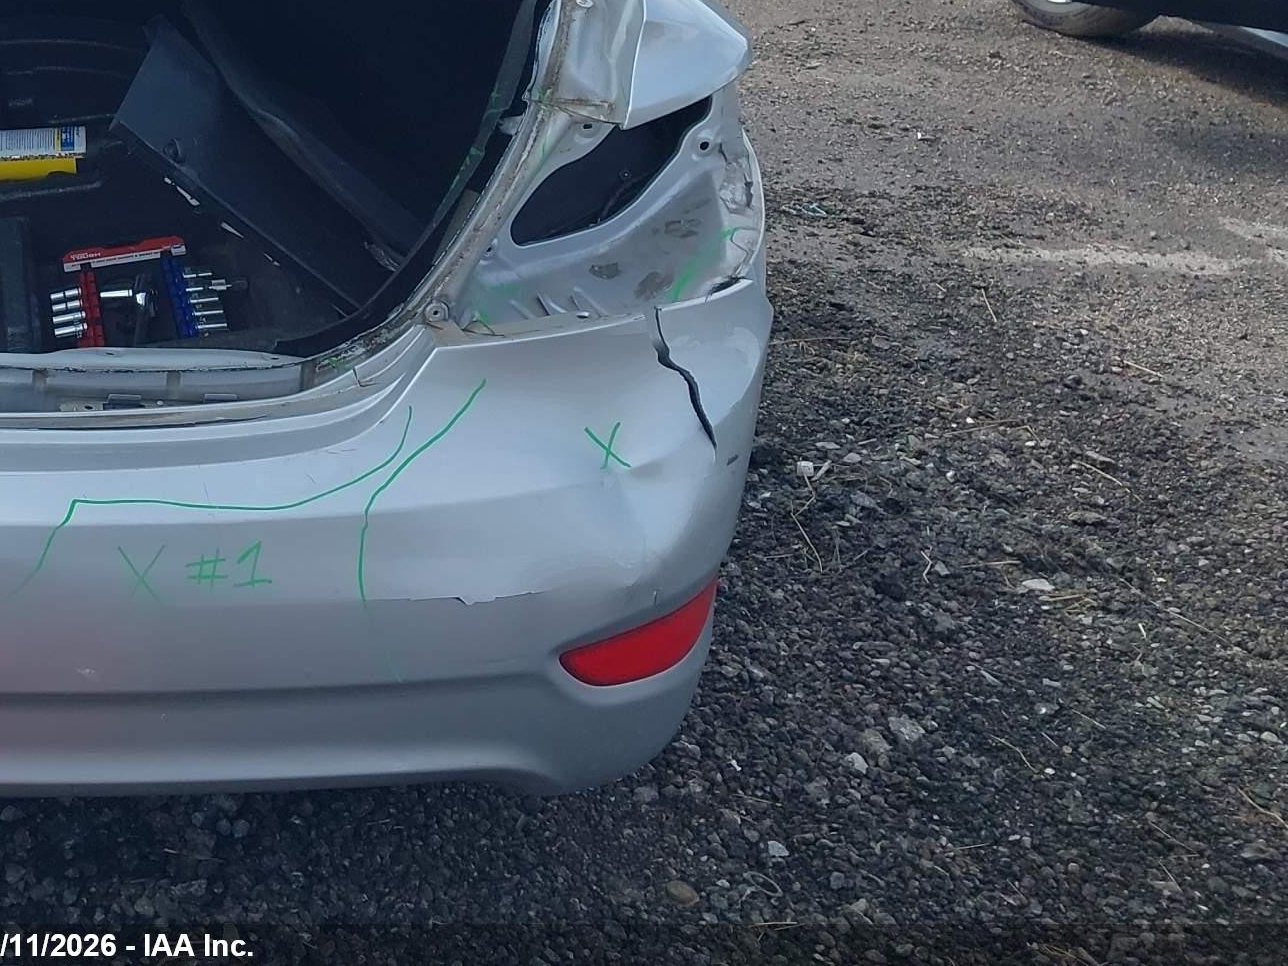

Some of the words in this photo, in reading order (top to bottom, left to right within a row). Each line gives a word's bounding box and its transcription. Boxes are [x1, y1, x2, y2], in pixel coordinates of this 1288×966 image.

[584, 421, 632, 470] X
[117, 544, 167, 602] X
[184, 540, 273, 592] #1
